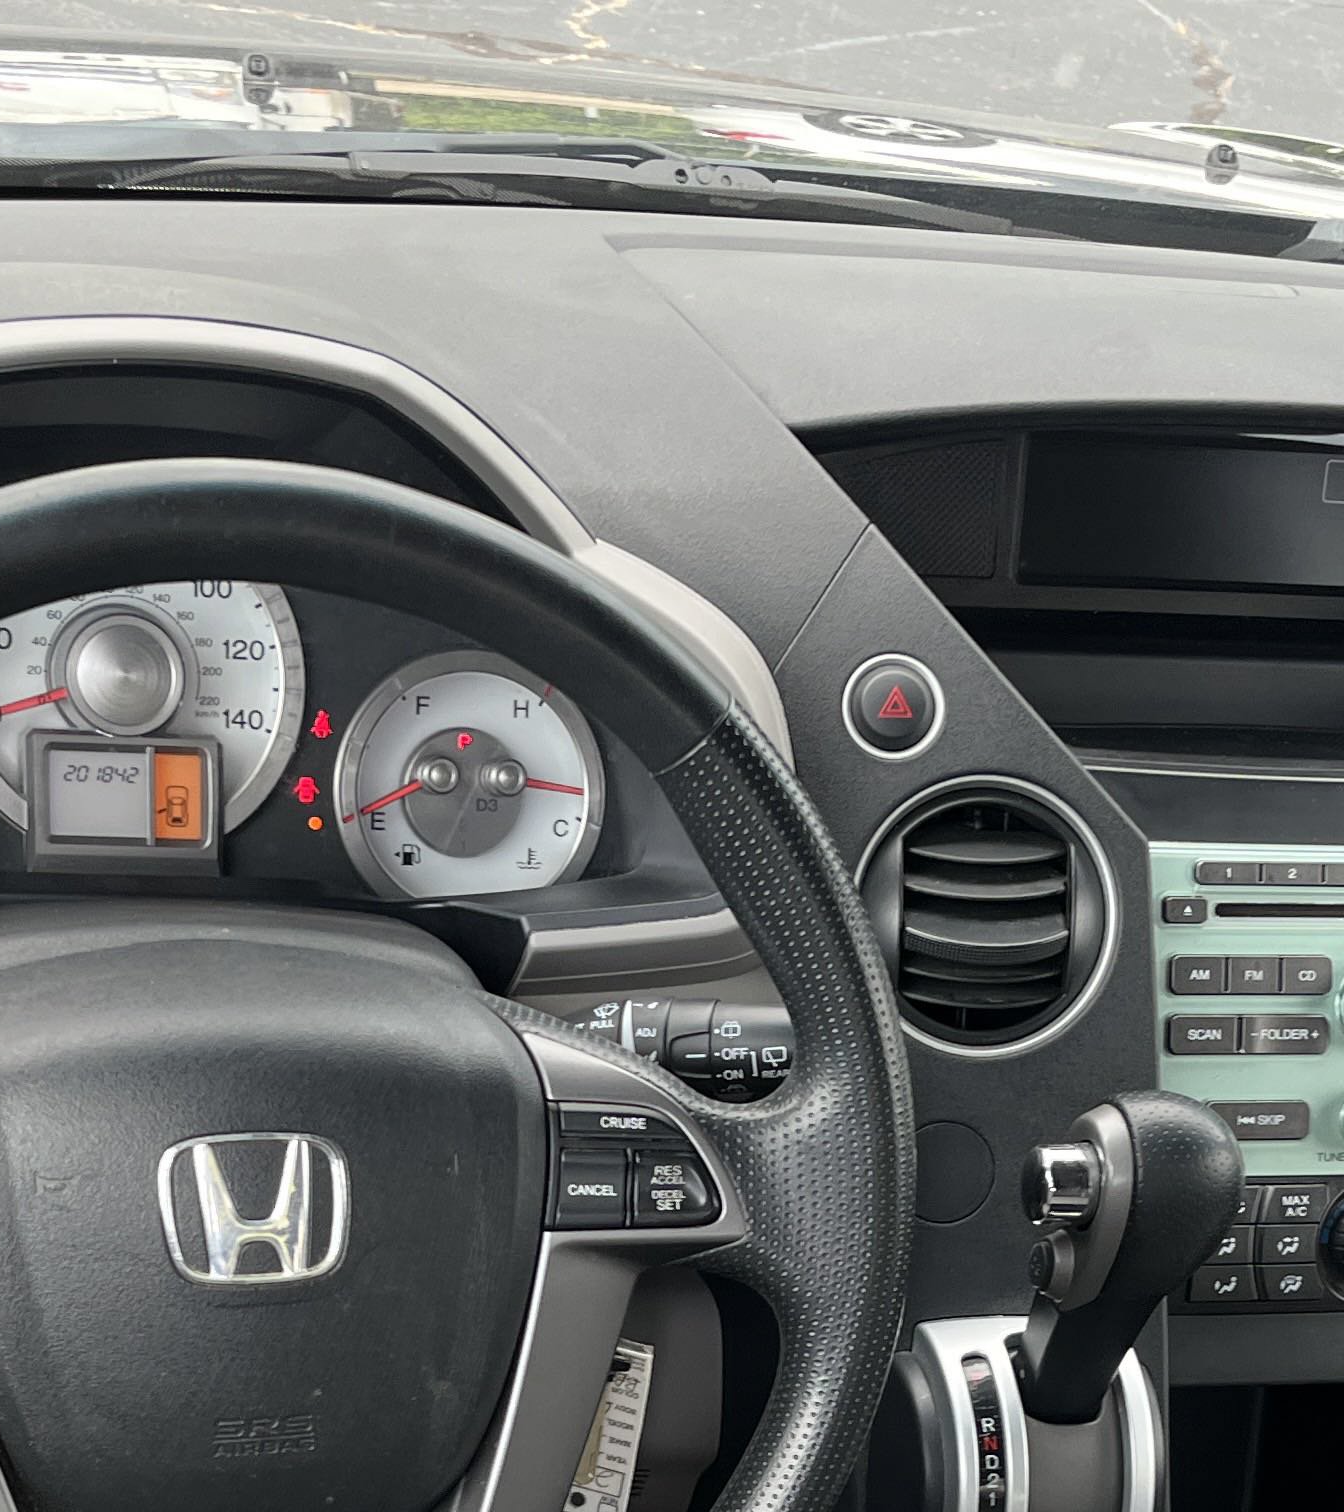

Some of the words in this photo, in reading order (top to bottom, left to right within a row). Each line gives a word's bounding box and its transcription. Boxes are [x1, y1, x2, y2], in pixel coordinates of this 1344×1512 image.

[193, 581, 233, 599] 100
[46, 610, 62, 620] 60
[177, 611, 194, 621] 160
[32, 636, 48, 646] 40
[195, 638, 213, 647] 180
[224, 639, 265, 661] 120
[26, 665, 42, 675] 20
[202, 666, 223, 677] 200
[199, 696, 220, 706] 220
[416, 696, 430, 715] F
[513, 700, 529, 718] H
[223, 709, 264, 731] 140
[63, 765, 140, 784] 201842
[476, 798, 498, 812] D3
[371, 812, 385, 831] E
[553, 819, 569, 836] C
[1225, 868, 1232, 879] 1
[1288, 869, 1297, 879] 2
[1189, 969, 1210, 981] AM
[1244, 969, 1263, 981] FM
[1297, 969, 1317, 981] CD
[589, 1020, 615, 1030] PULL
[635, 1027, 657, 1038] ADJ
[1187, 1028, 1222, 1041] SCAN
[721, 1047, 749, 1060] OFF
[723, 1069, 745, 1080] ON
[599, 1116, 647, 1130] CRUISE
[1256, 1114, 1286, 1126] SKIP
[654, 1165, 682, 1176] RES
[650, 1175, 686, 1185] ACCEL
[567, 1184, 618, 1197] CANCEL
[651, 1190, 687, 1200] DECEL
[656, 1199, 682, 1211] SET
[1282, 1195, 1310, 1206] MAX
[1285, 1206, 1307, 1217] A/C
[215, 1414, 313, 1438] SRS
[981, 1417, 995, 1433] R
[983, 1436, 999, 1450] N
[984, 1454, 999, 1470] D
[987, 1473, 999, 1488] 2
[988, 1492, 997, 1506] 1
